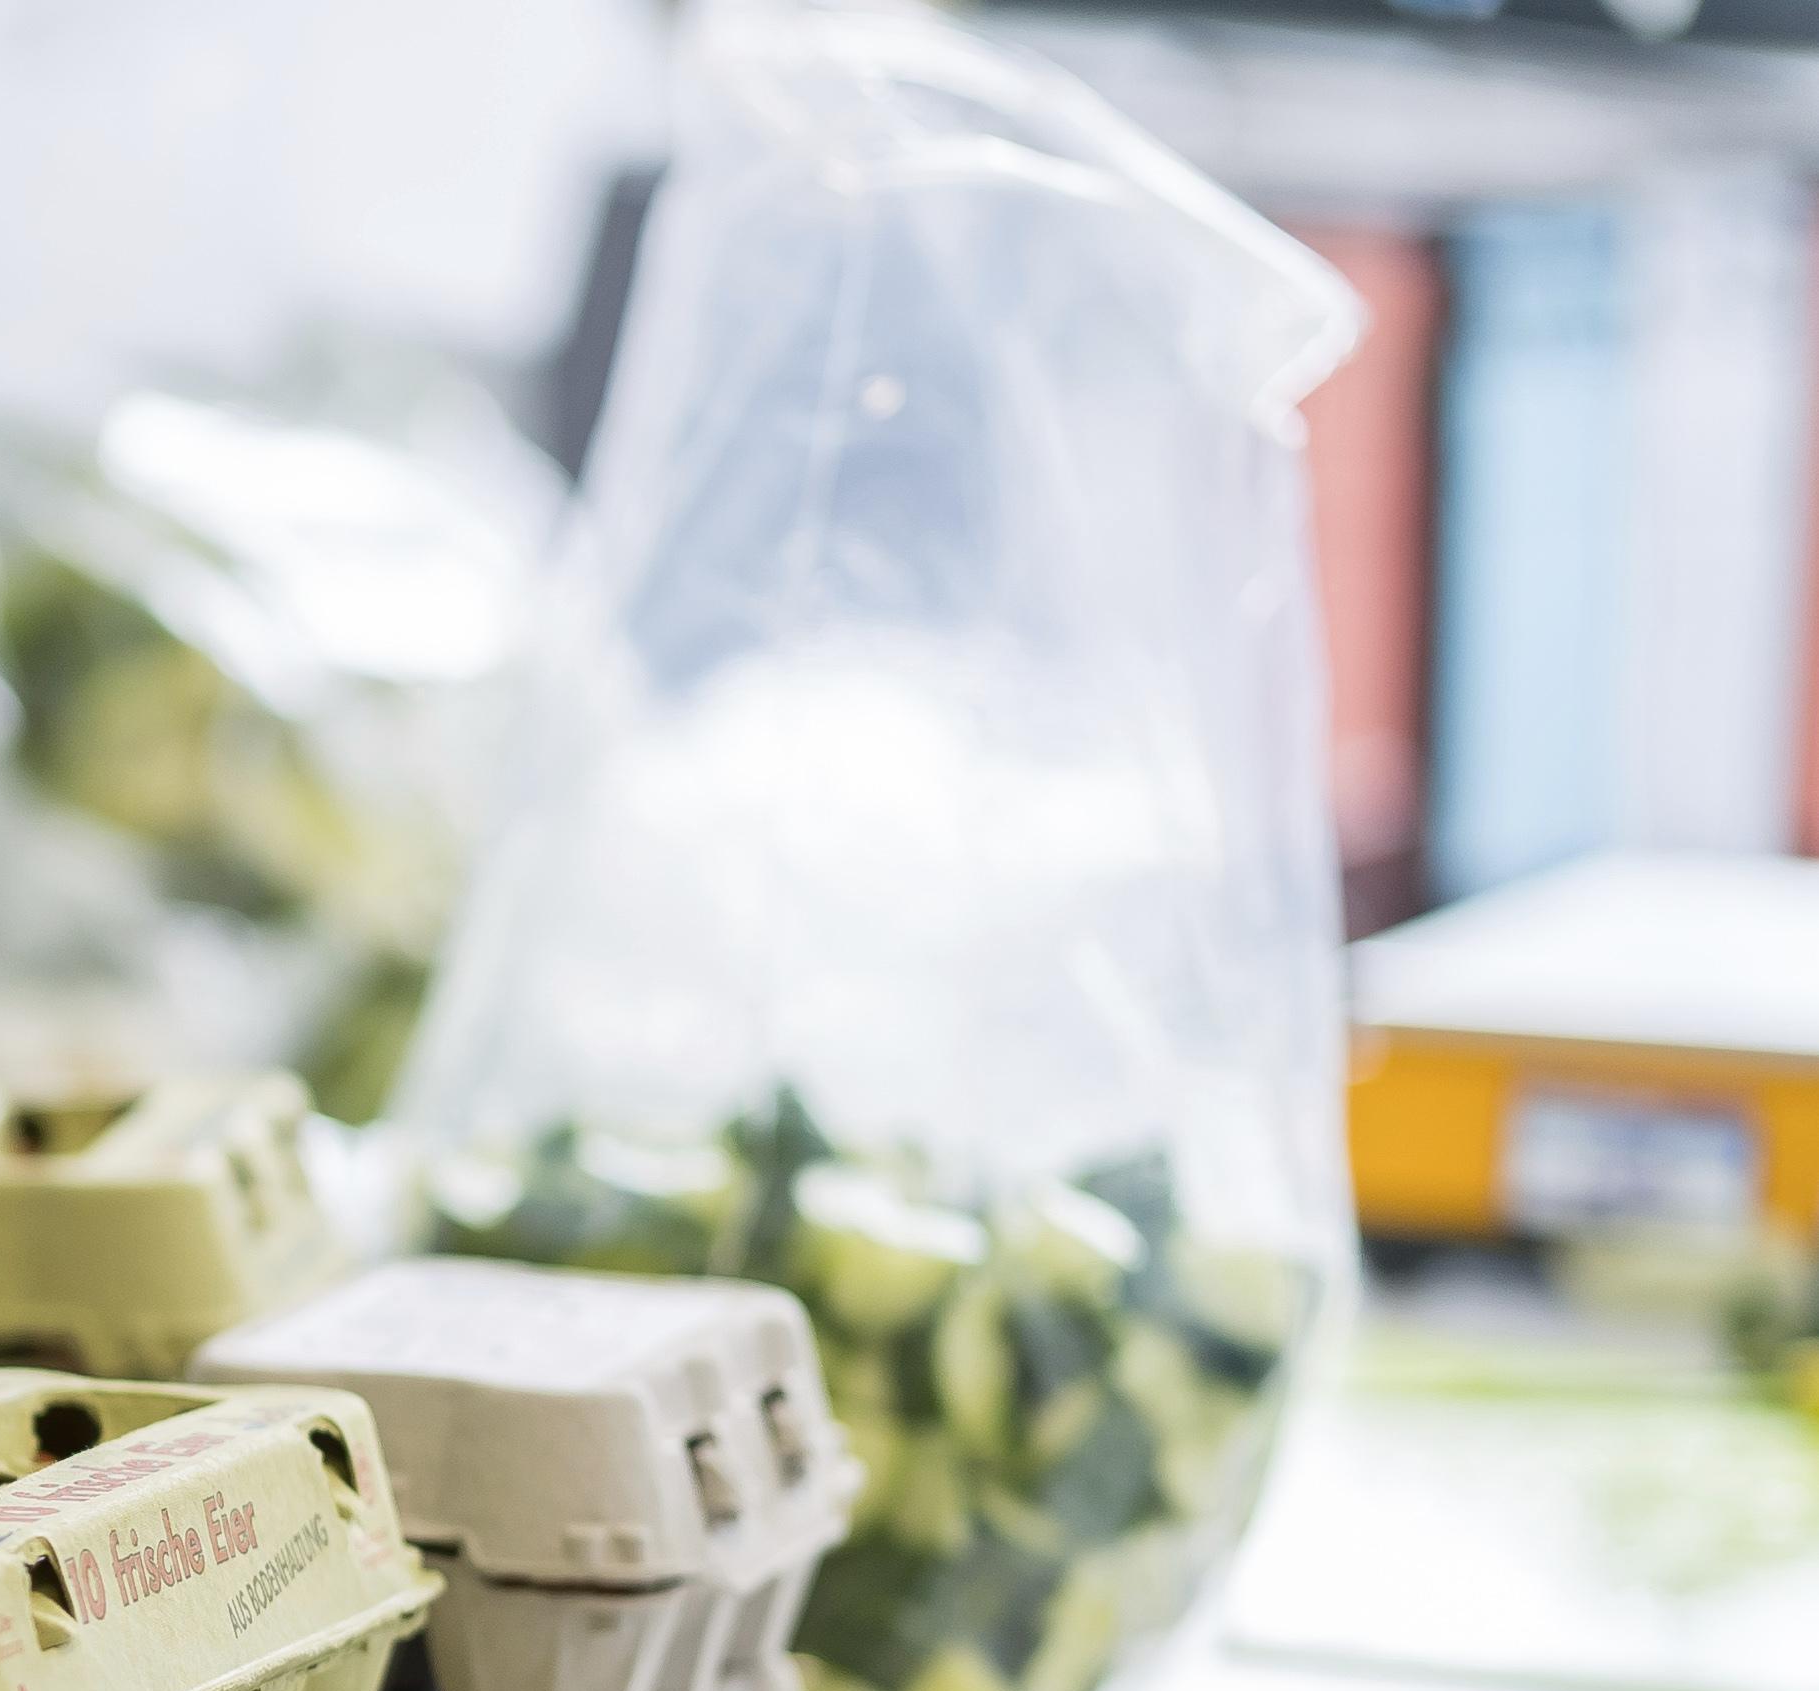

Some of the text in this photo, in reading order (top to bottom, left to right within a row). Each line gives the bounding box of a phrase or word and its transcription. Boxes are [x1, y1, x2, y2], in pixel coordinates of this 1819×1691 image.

[65, 1490, 259, 1625] 10 frische Eier
[227, 1512, 329, 1639] AUS BODENHALTUNG
